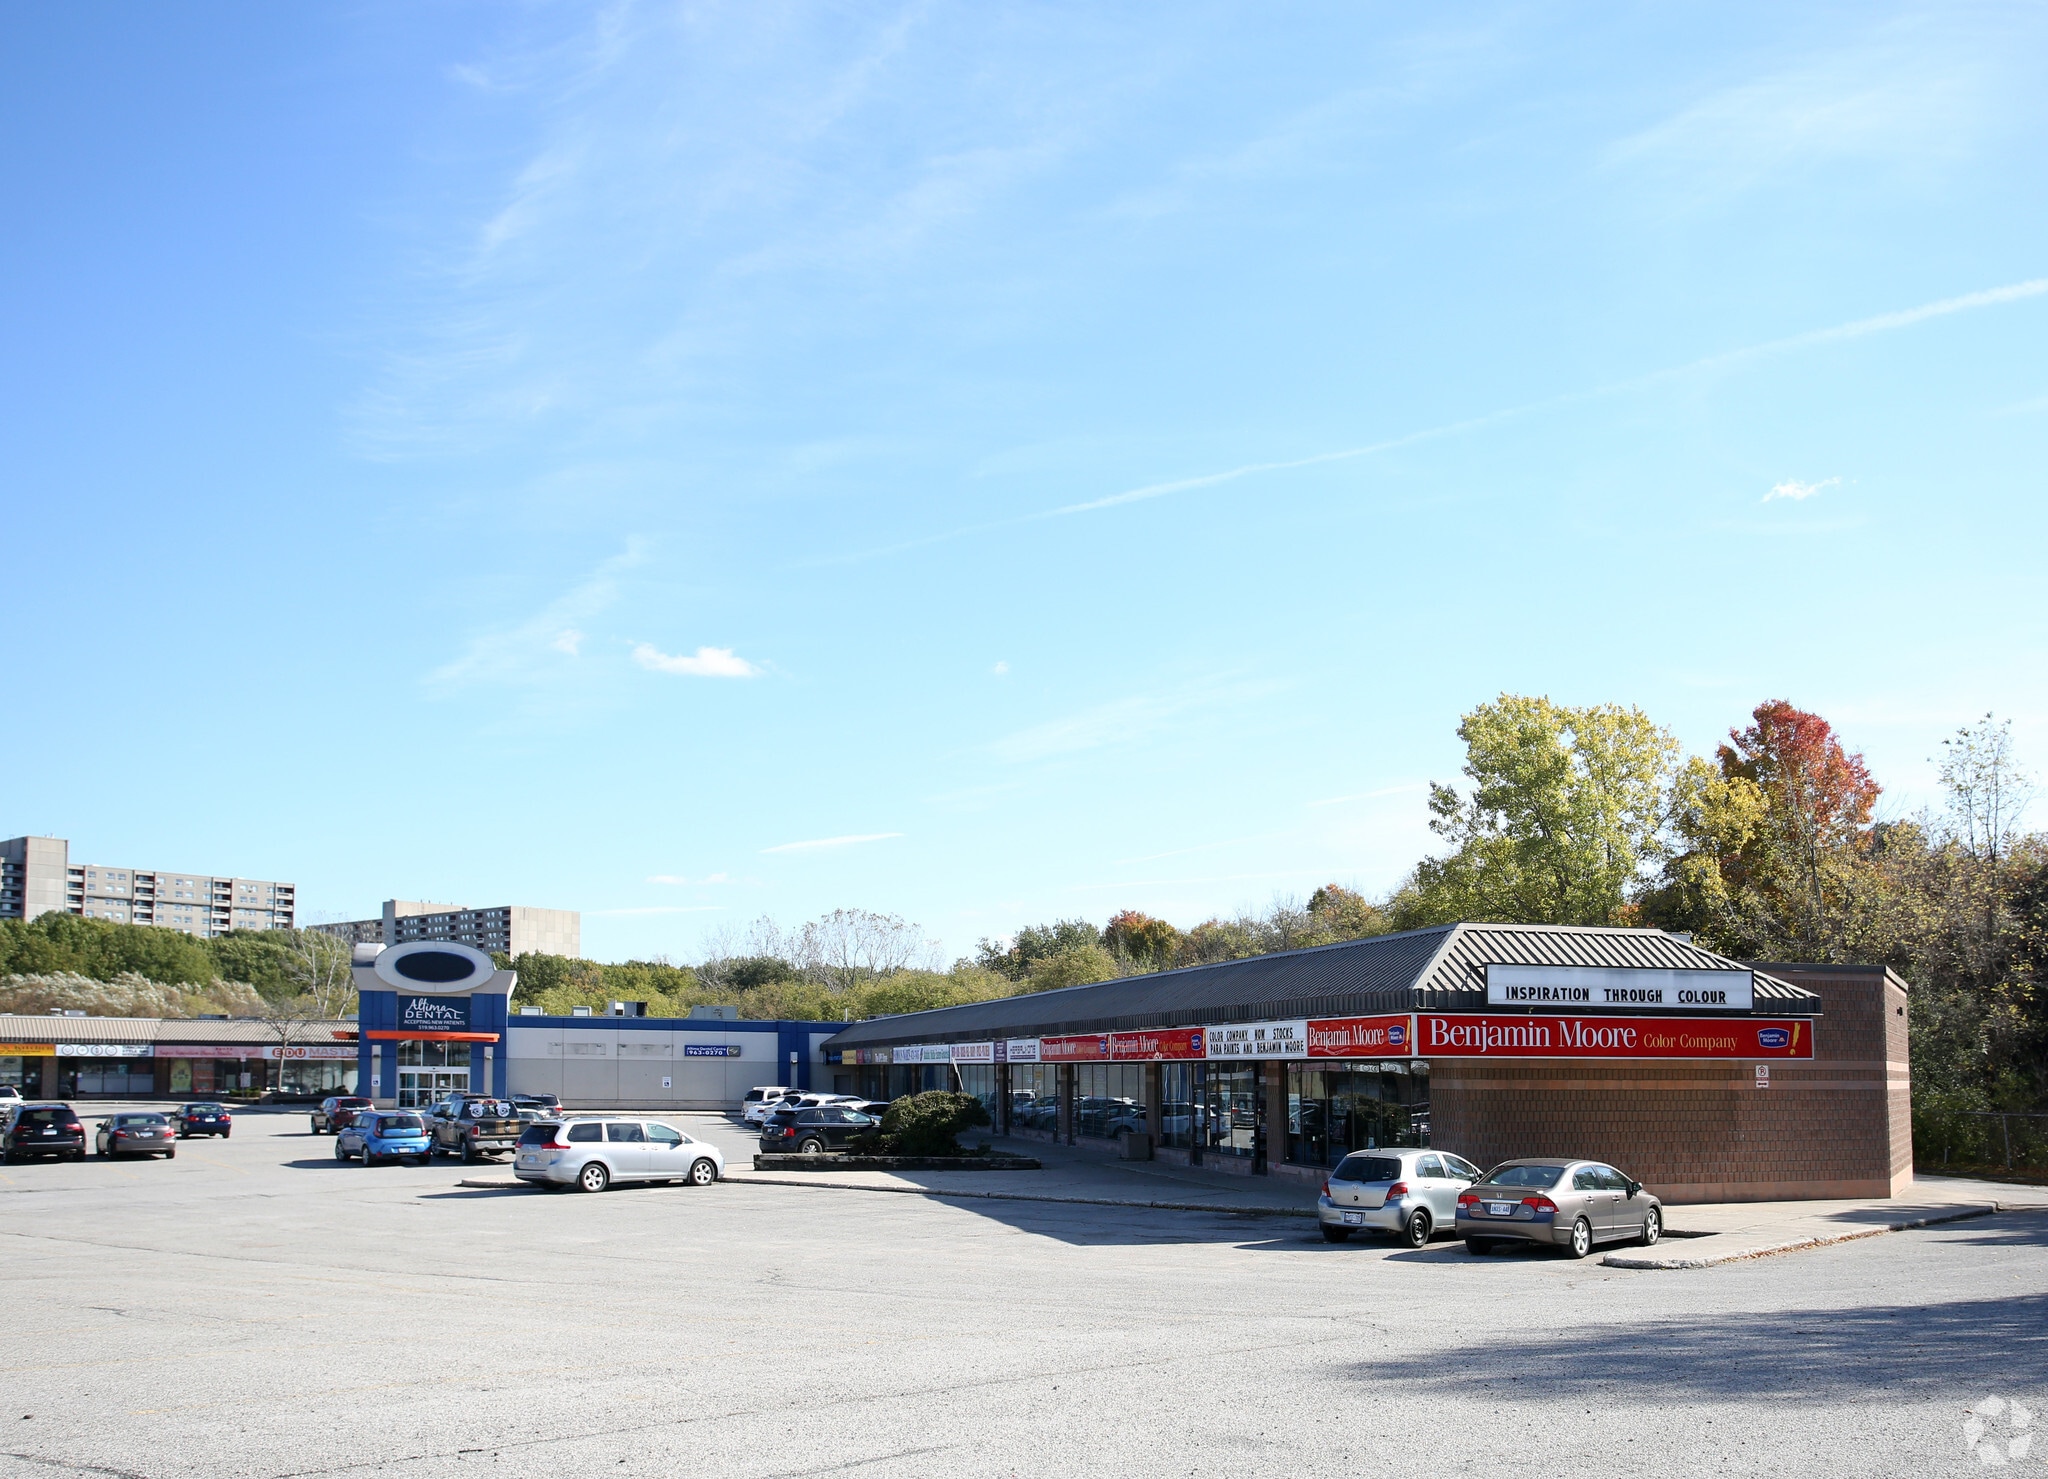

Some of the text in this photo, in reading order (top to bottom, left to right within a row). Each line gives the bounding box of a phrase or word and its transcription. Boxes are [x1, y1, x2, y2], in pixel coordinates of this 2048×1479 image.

[1505, 986, 1726, 1003] INSPIRATION THROUGH COLOUR
[406, 998, 464, 1013] Altima
[405, 1011, 461, 1020] DENTAL
[1209, 1031, 1224, 1042] COLOR
[1226, 1030, 1249, 1042] COMPANY
[1273, 1027, 1293, 1040] STOCKS
[1309, 1024, 1384, 1051] Benjamin Moore
[1429, 1019, 1739, 1052] Benjamin Moore Color Company
[1061, 1039, 1076, 1055] Moore
[1113, 1036, 1138, 1056] Benjamin
[1139, 1035, 1158, 1053] Moore
[1210, 1043, 1222, 1054] PARA
[1223, 1043, 1240, 1054] PAINTS
[1243, 1042, 1253, 1054] AND
[1256, 1041, 1281, 1053] BENJAMIN
